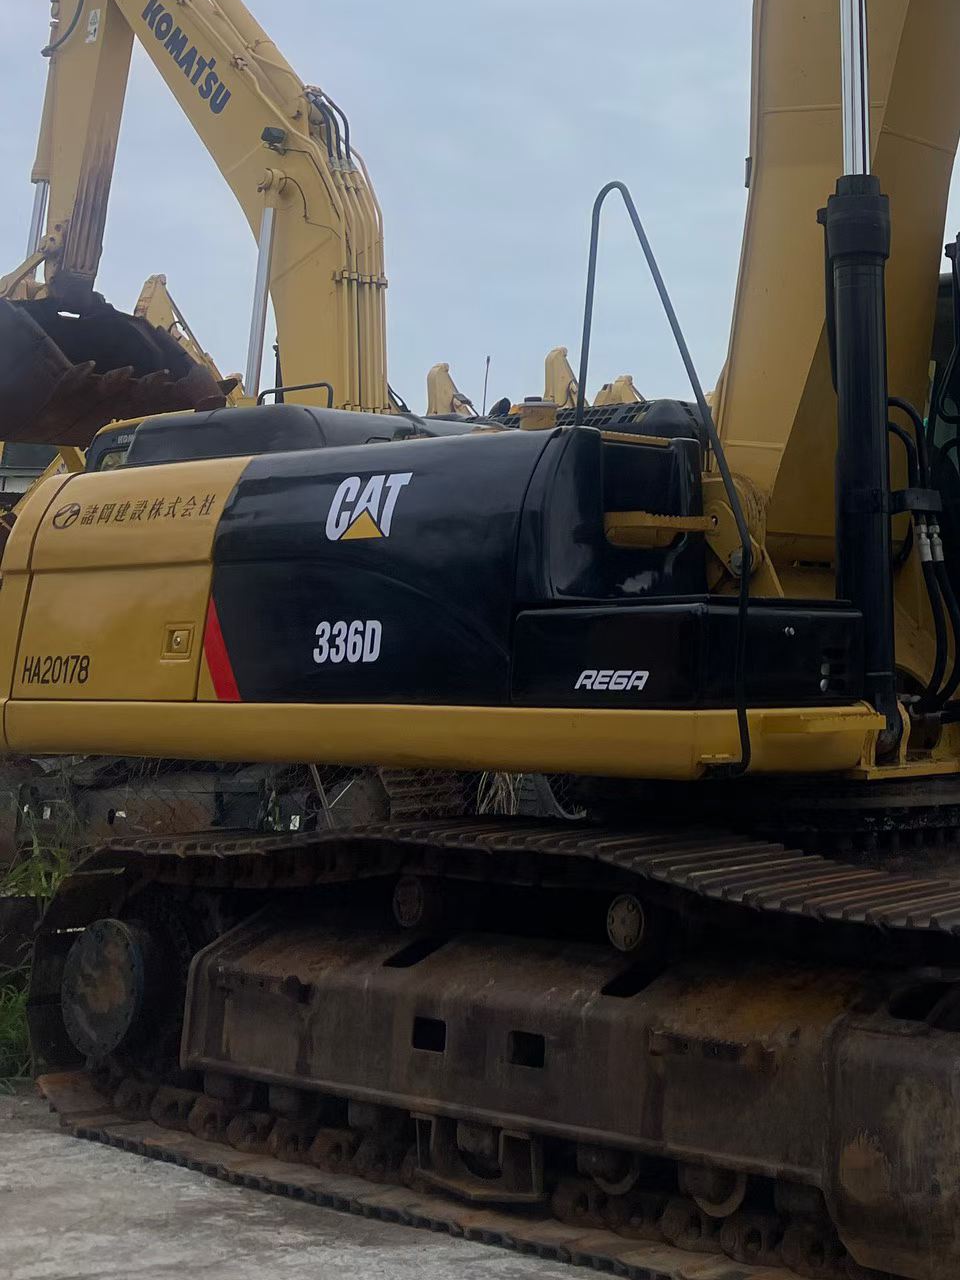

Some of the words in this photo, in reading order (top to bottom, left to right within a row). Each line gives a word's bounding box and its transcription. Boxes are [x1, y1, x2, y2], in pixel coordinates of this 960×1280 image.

[324, 472, 413, 541] CAT
[313, 620, 382, 663] 336D
[21, 655, 90, 685] HA20178
[574, 669, 650, 691] REGA
